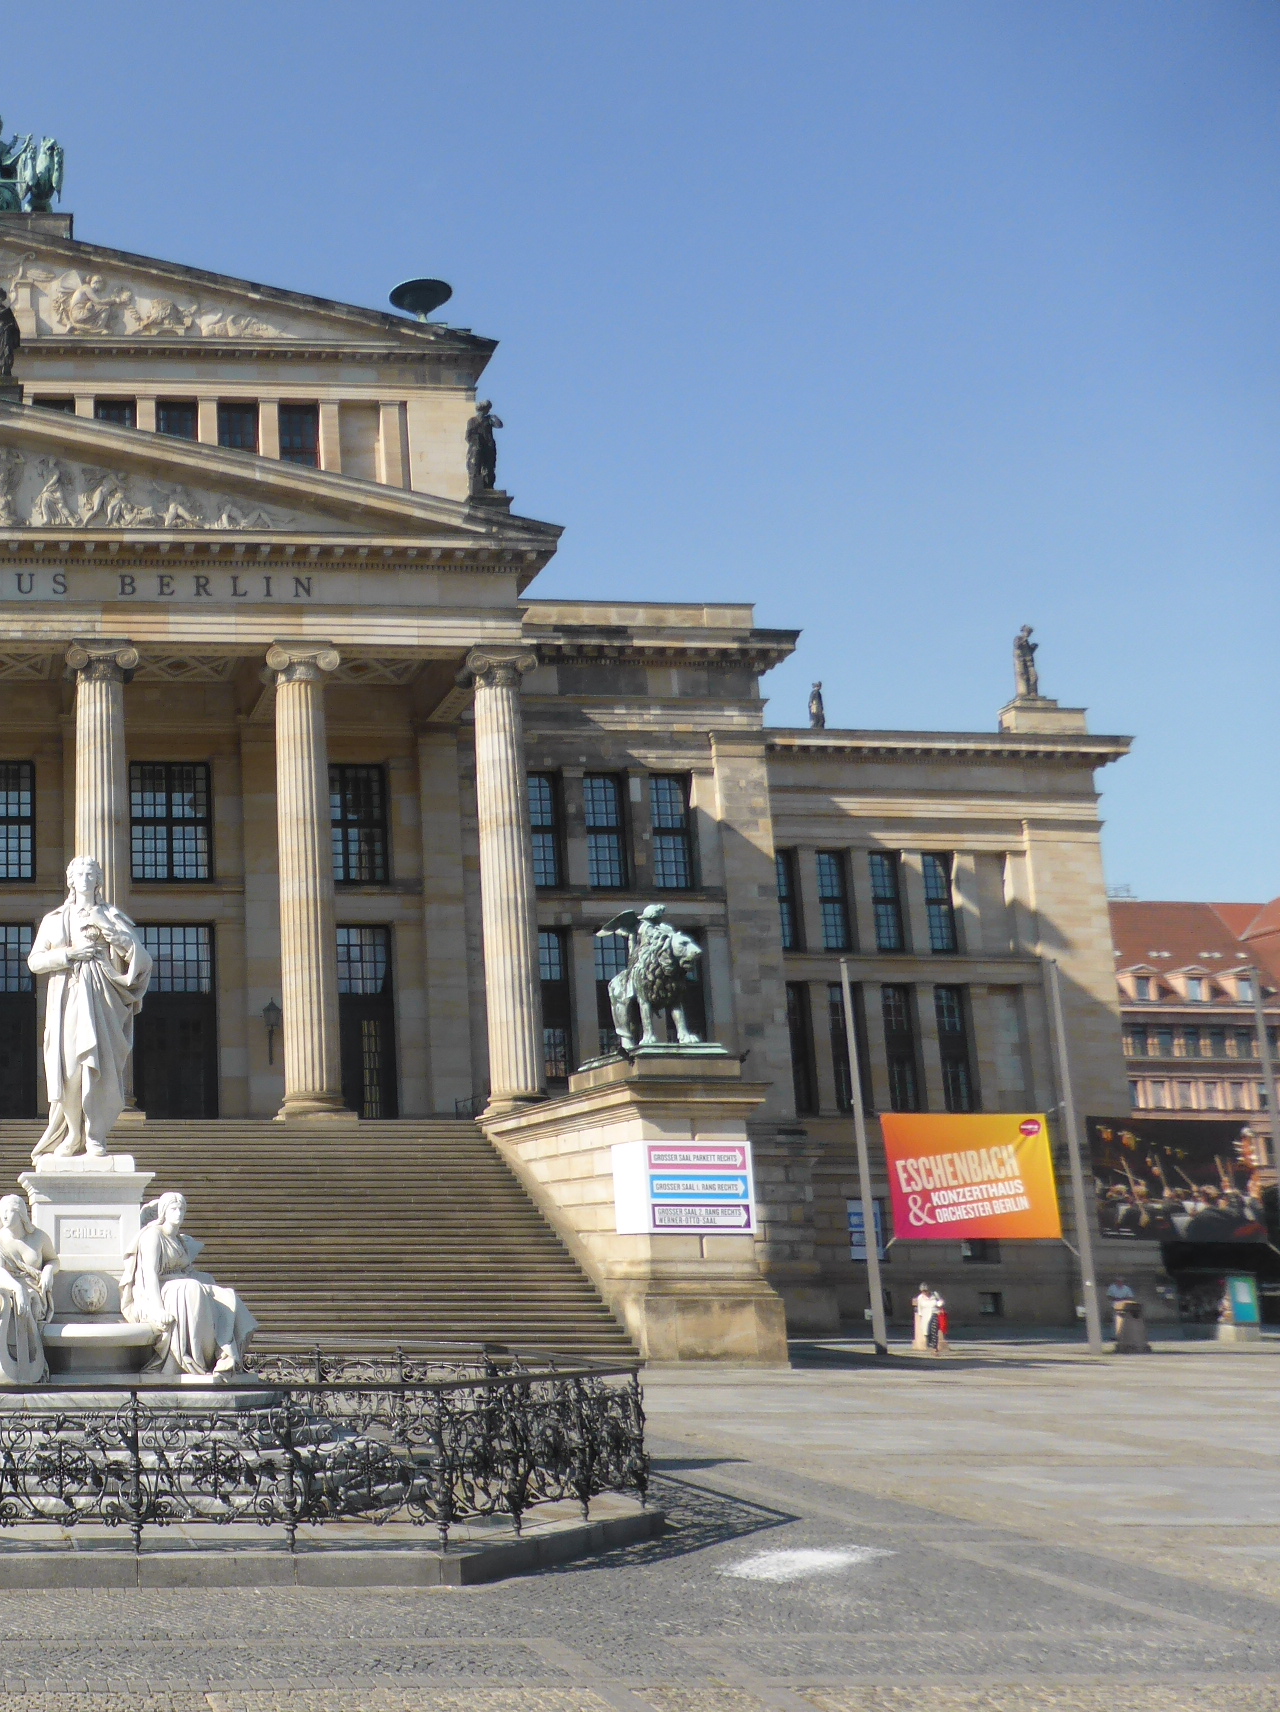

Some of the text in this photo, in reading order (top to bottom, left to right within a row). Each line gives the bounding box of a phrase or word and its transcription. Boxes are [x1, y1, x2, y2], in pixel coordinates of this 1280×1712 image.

[119, 575, 315, 599] BERLIN
[653, 1154, 737, 1162] GROSSER SAAL PARKETT RECHTS
[895, 1145, 1020, 1193] ESCHENBACH
[655, 1183, 681, 1191] GROSSER
[681, 1183, 695, 1191] SAAL
[701, 1183, 717, 1191] RANG
[717, 1183, 738, 1191] RECHTS
[931, 1179, 1025, 1206] KONZERTHAUS
[657, 1208, 683, 1216] GROSSER
[683, 1208, 698, 1216] SAAL
[704, 1208, 720, 1216] RANG
[720, 1208, 742, 1216] RECHTS
[658, 1217, 718, 1225] WERNER-OTTO-SAAL
[908, 1195, 936, 1227] &
[935, 1196, 1030, 1223] ORCHESTER BERLIN
